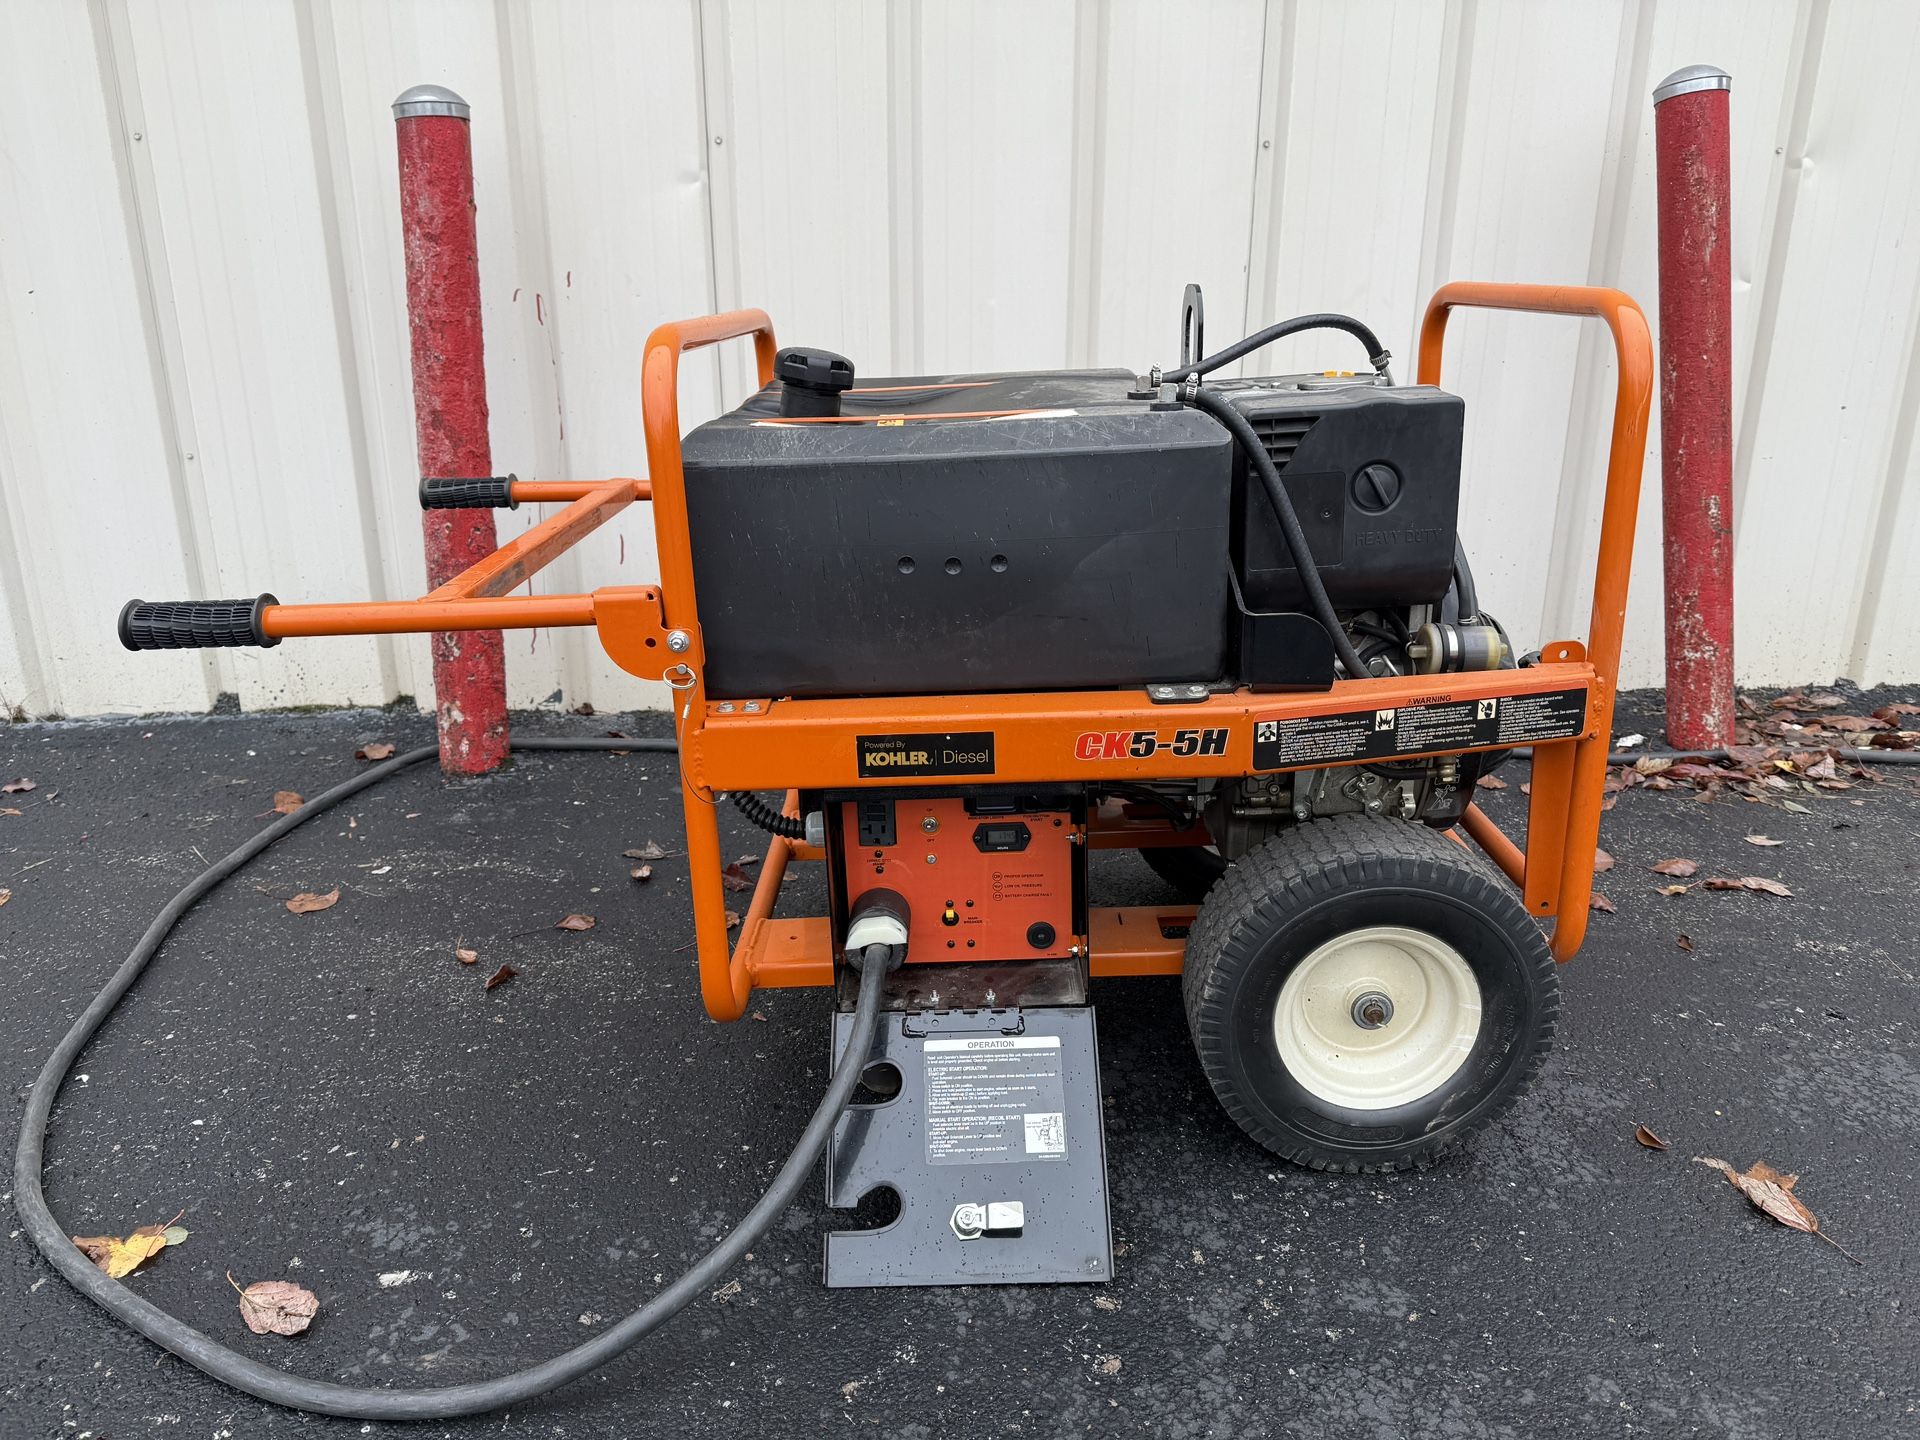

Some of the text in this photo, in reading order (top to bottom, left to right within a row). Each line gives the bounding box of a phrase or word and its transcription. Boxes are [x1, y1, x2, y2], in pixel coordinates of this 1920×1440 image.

[1354, 527, 1443, 546] HEAVY DUTY
[1413, 695, 1452, 705] WARNING
[864, 740, 906, 749] Powered By
[1074, 728, 1231, 761] CK5-5H
[943, 749, 989, 764] Diesel
[967, 1040, 1015, 1049] OPERATION
